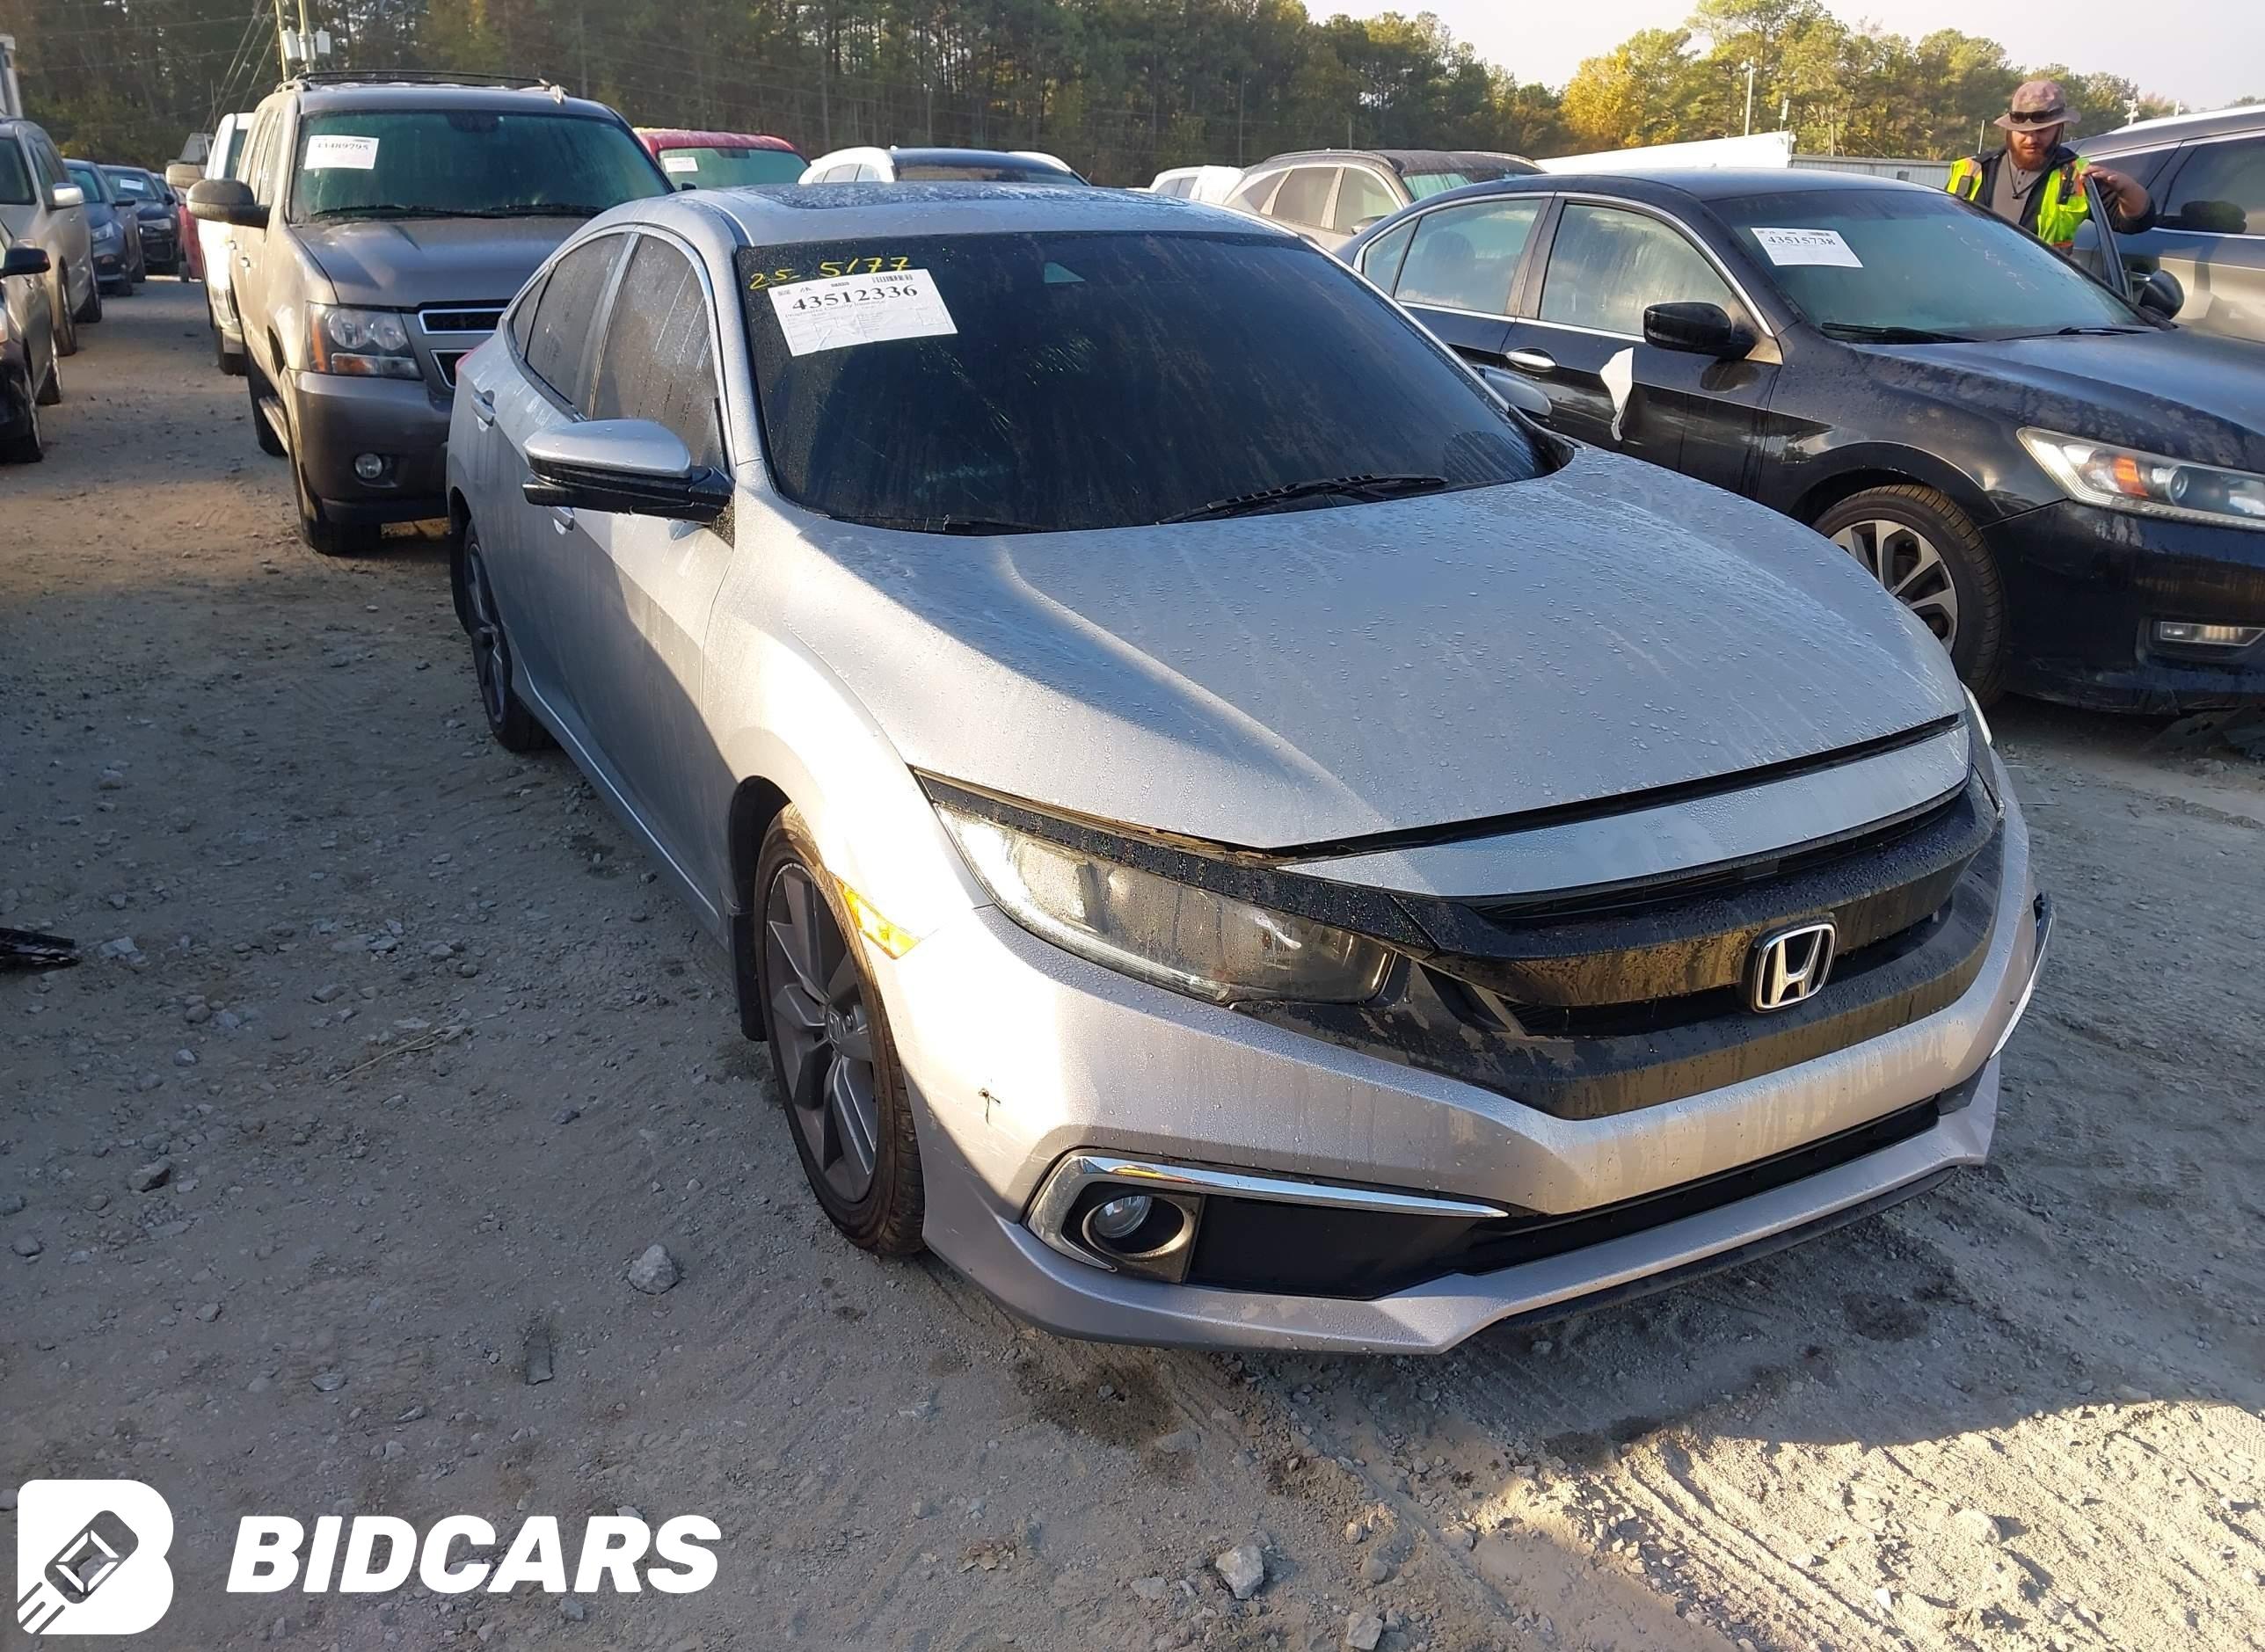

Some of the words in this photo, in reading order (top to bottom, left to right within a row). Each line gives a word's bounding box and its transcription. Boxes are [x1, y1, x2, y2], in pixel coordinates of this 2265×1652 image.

[1767, 236, 1836, 245] 43515738
[819, 257, 912, 277] 5177
[792, 285, 918, 310] 43512336
